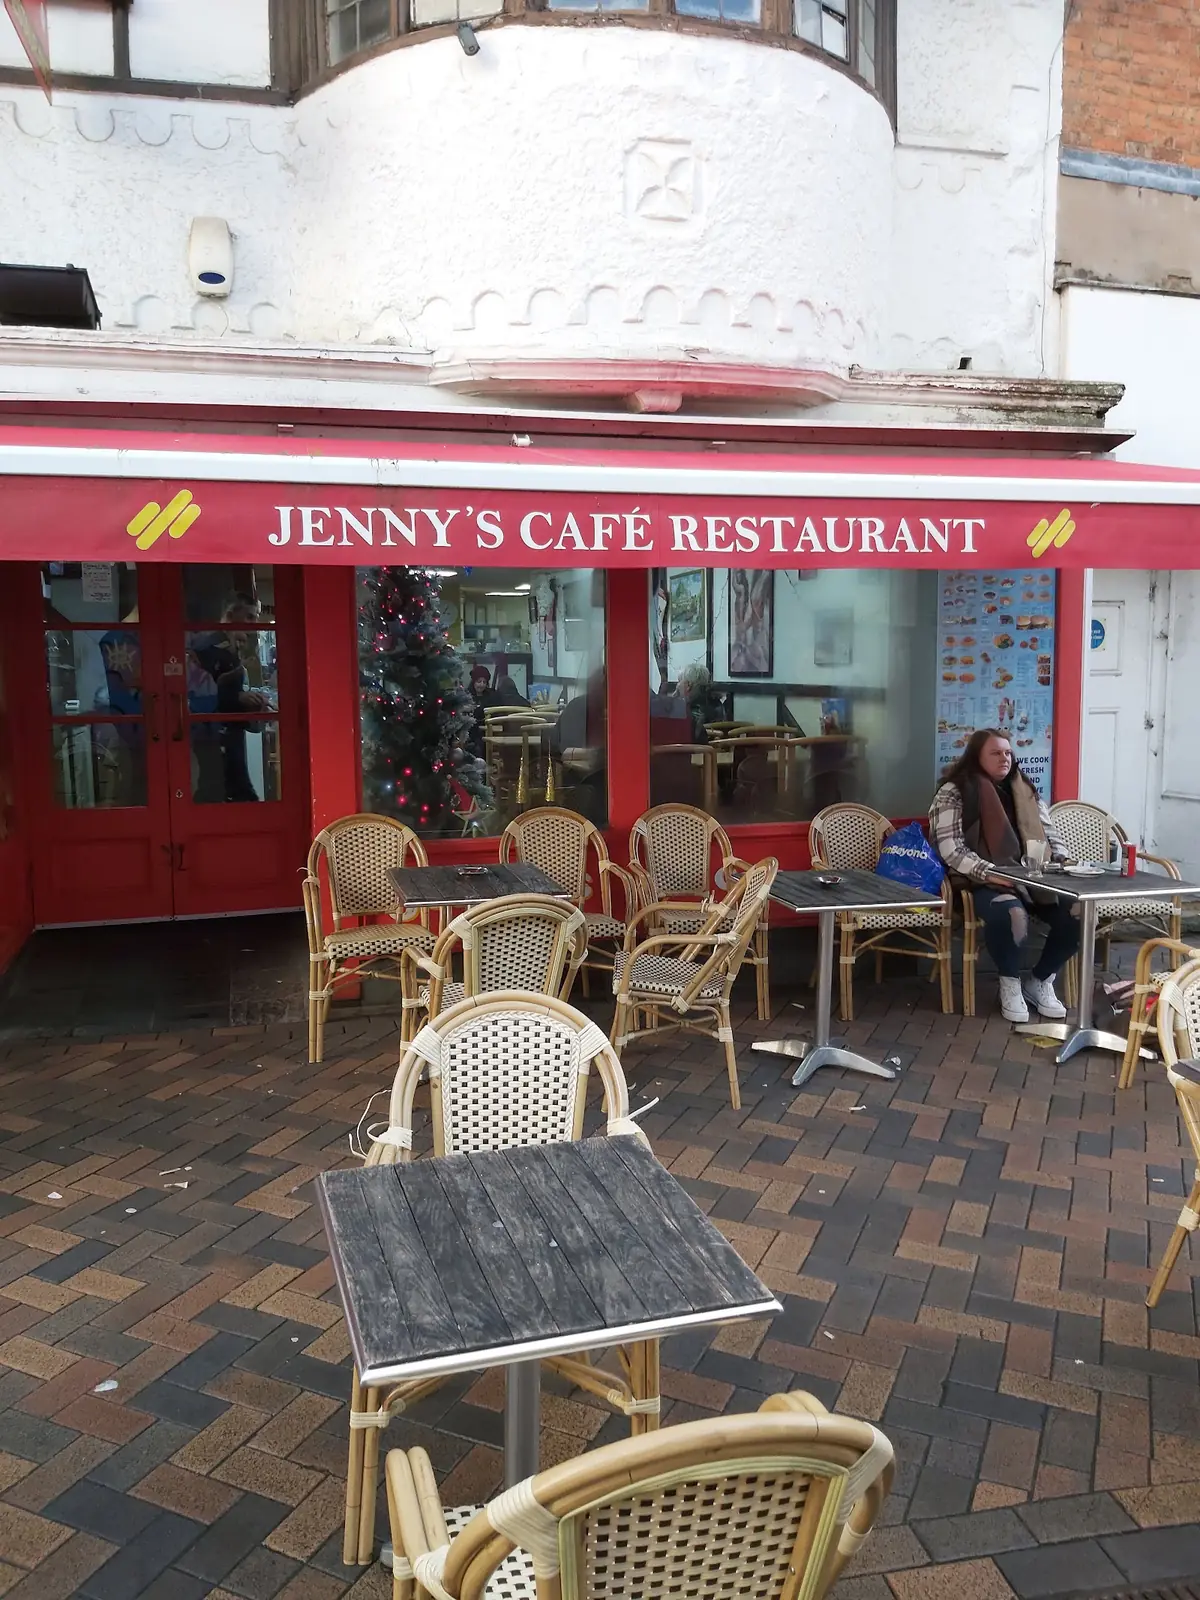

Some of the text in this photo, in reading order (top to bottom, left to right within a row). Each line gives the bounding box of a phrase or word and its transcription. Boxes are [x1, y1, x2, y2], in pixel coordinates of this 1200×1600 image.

[268, 505, 985, 553] JENNY'S CAFÉ RESTAURANT
[1030, 756, 1049, 764] COOK
